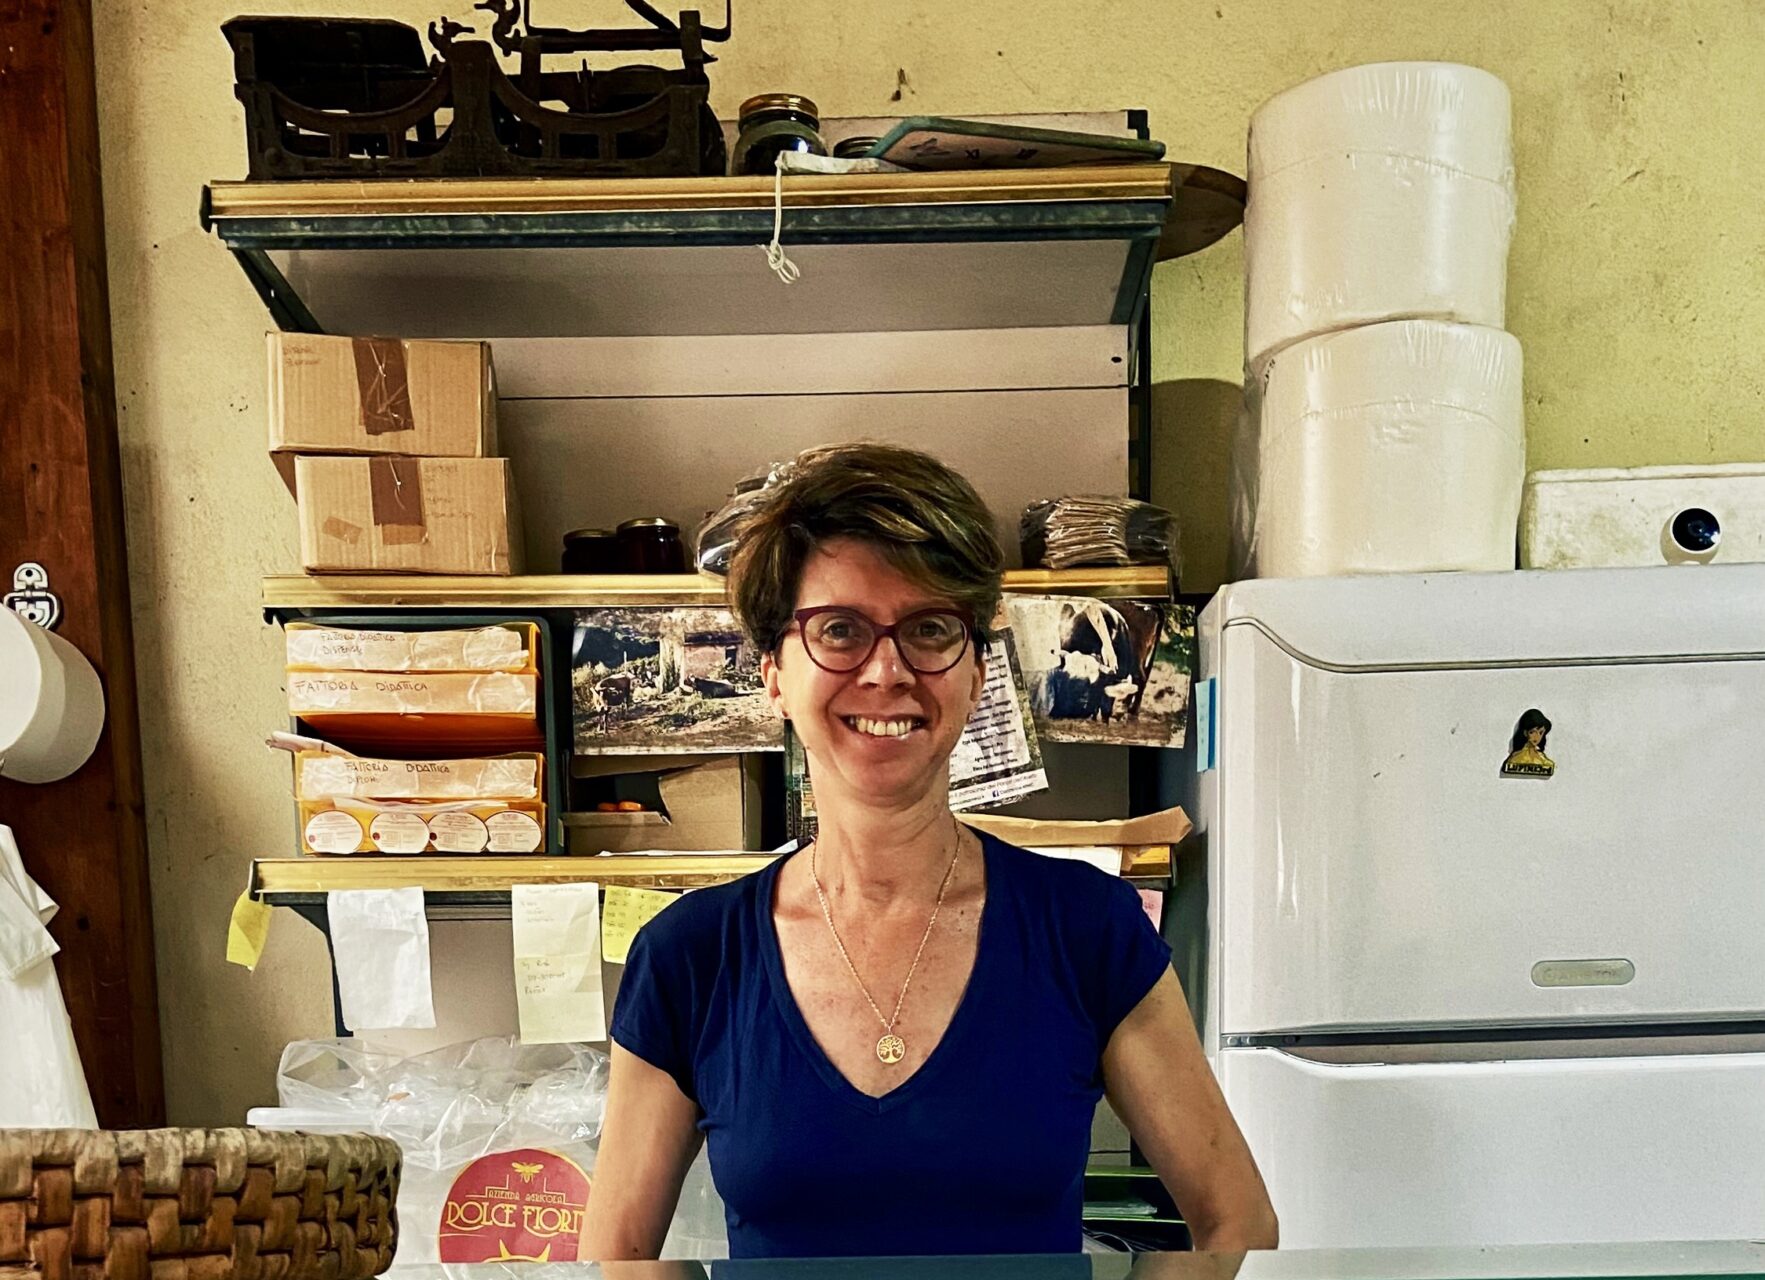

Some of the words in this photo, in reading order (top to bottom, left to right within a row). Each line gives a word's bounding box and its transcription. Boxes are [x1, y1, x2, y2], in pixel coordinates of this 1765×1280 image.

[294, 680, 359, 694] FATTORIA
[488, 1189, 521, 1201] AZIENDA
[525, 1192, 564, 1204] AGRICOLA
[446, 1200, 516, 1231] DOLCE
